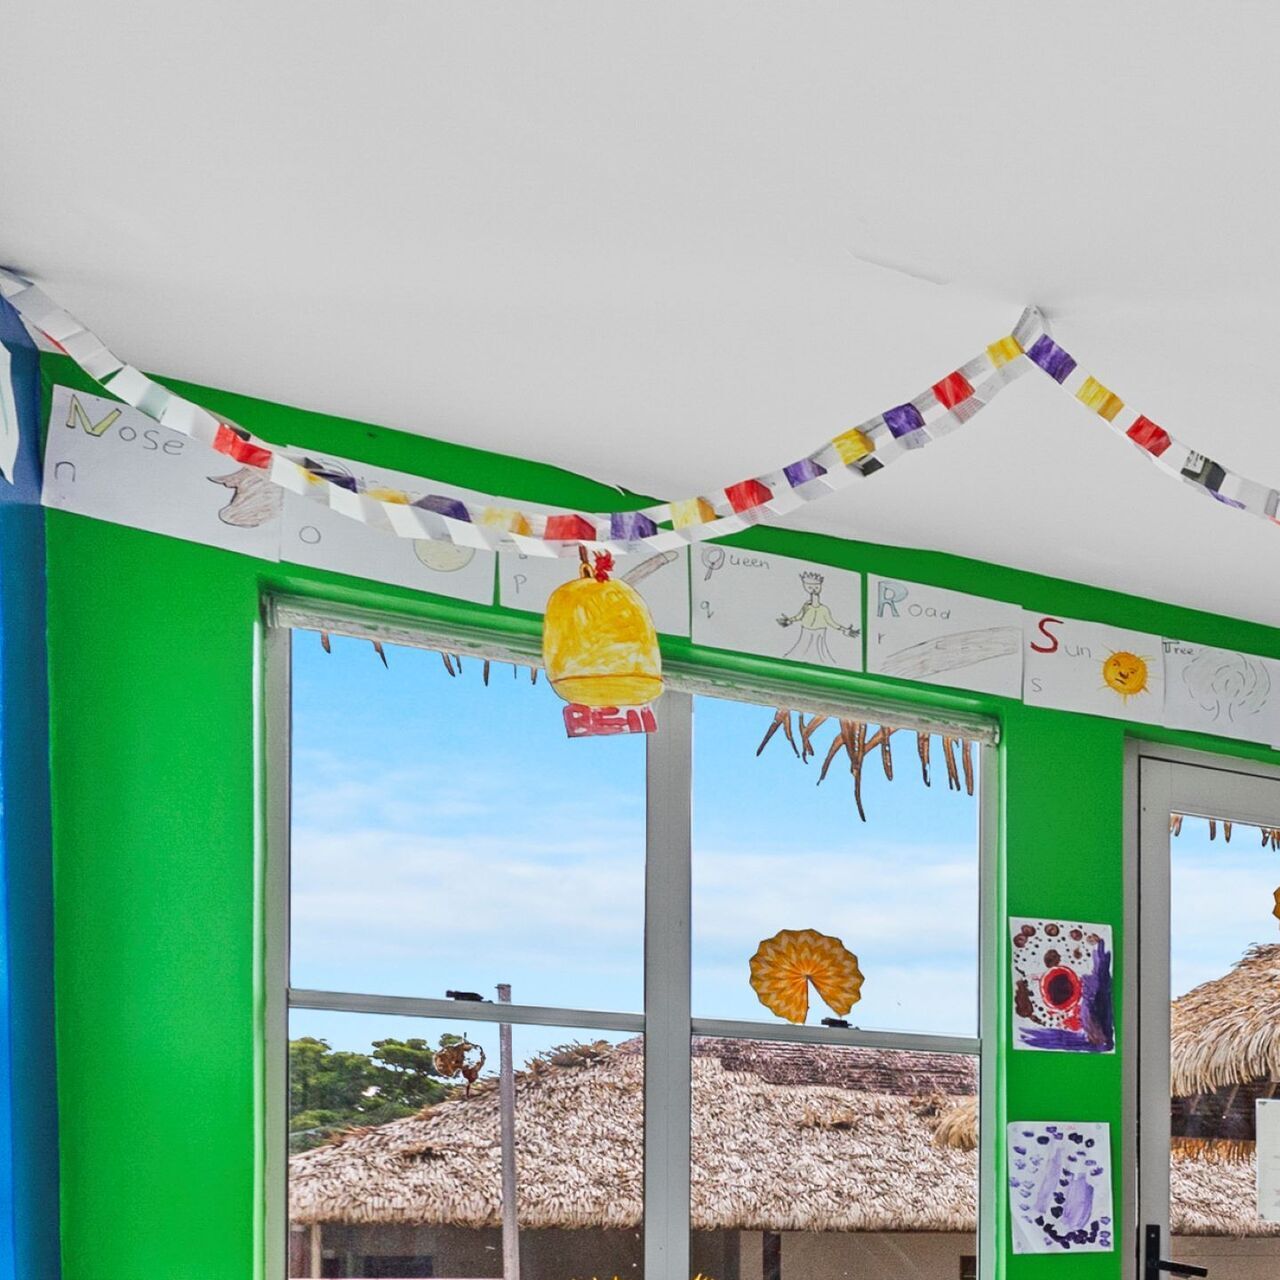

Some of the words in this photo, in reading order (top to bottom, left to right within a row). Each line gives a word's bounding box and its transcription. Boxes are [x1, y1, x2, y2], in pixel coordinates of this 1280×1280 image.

[65, 394, 185, 456] Nose
[701, 546, 770, 581] Queen
[876, 581, 951, 621] Road
[1030, 617, 1091, 659] Sun
